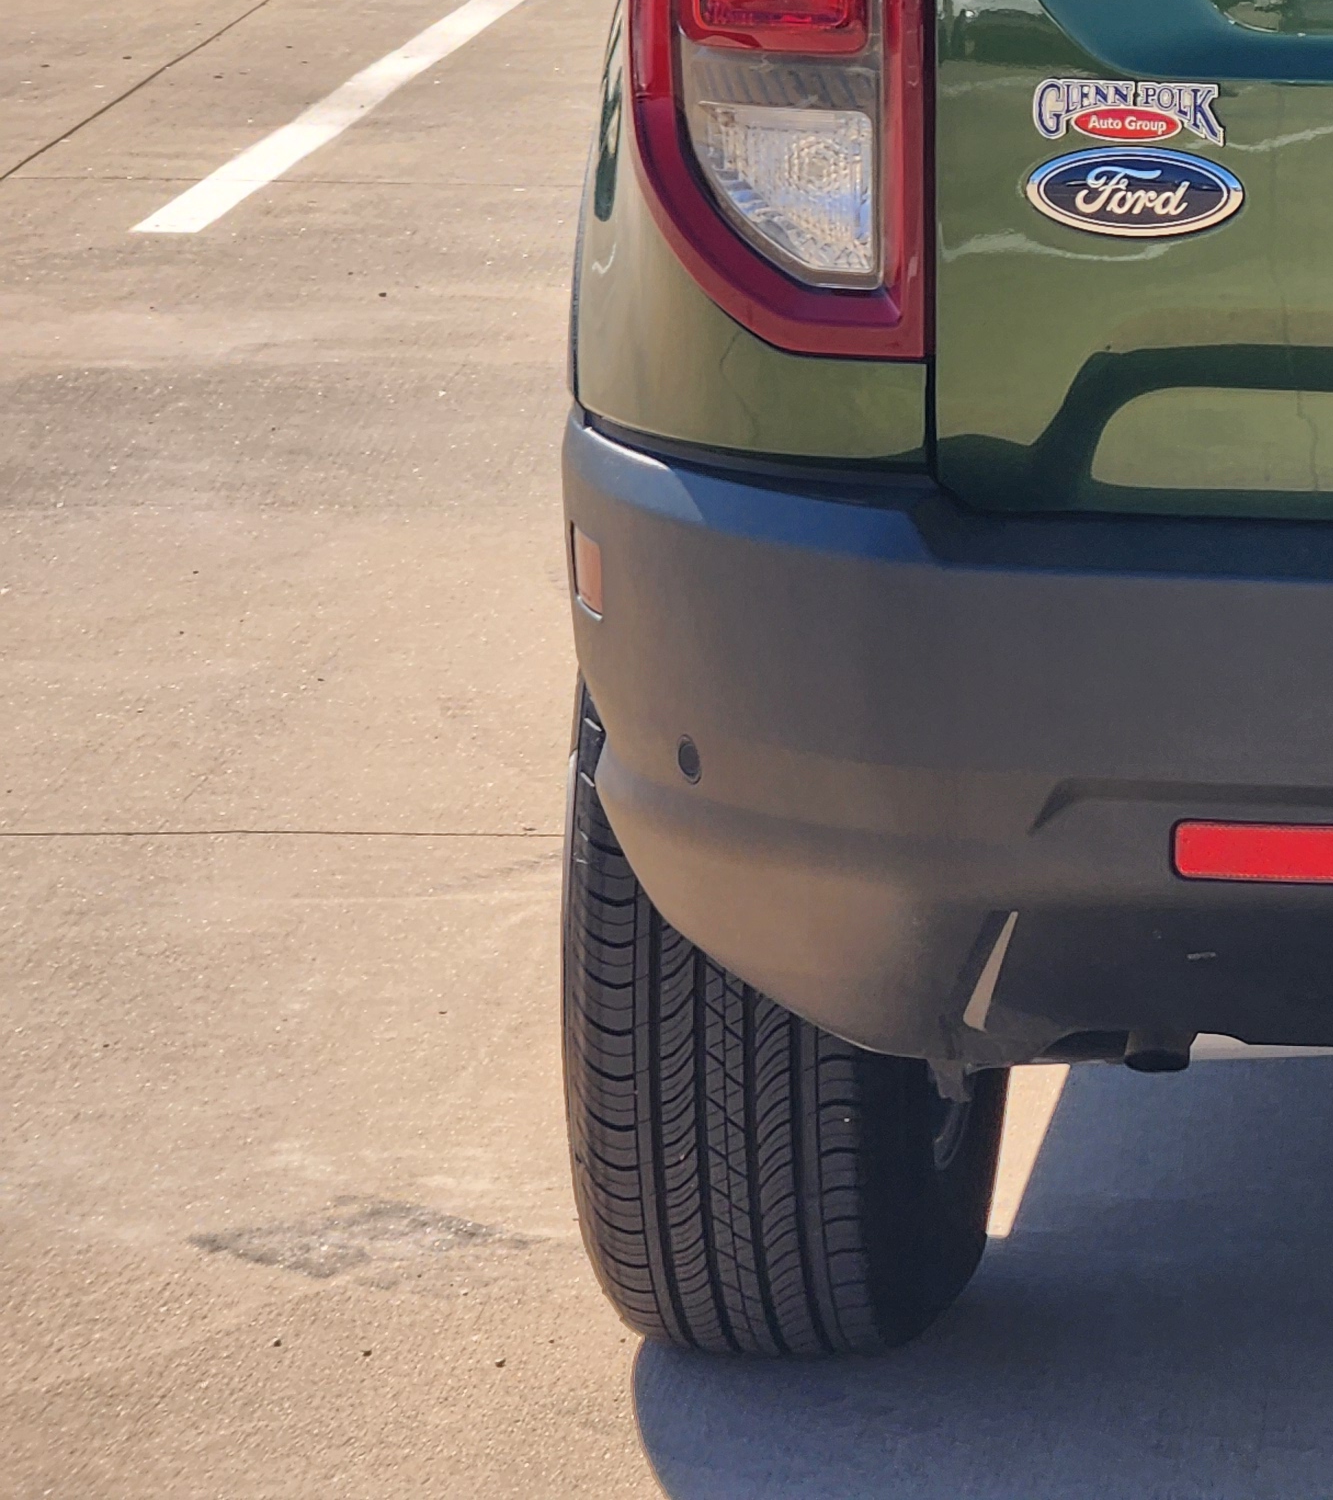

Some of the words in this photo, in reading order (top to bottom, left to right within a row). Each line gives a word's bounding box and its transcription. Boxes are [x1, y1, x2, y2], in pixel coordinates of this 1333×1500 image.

[1035, 81, 1131, 137] GLENN
[1143, 86, 1224, 145] POLK
[1088, 114, 1122, 130] Auto
[1124, 116, 1167, 135] Group
[1074, 165, 1190, 216] Ford
